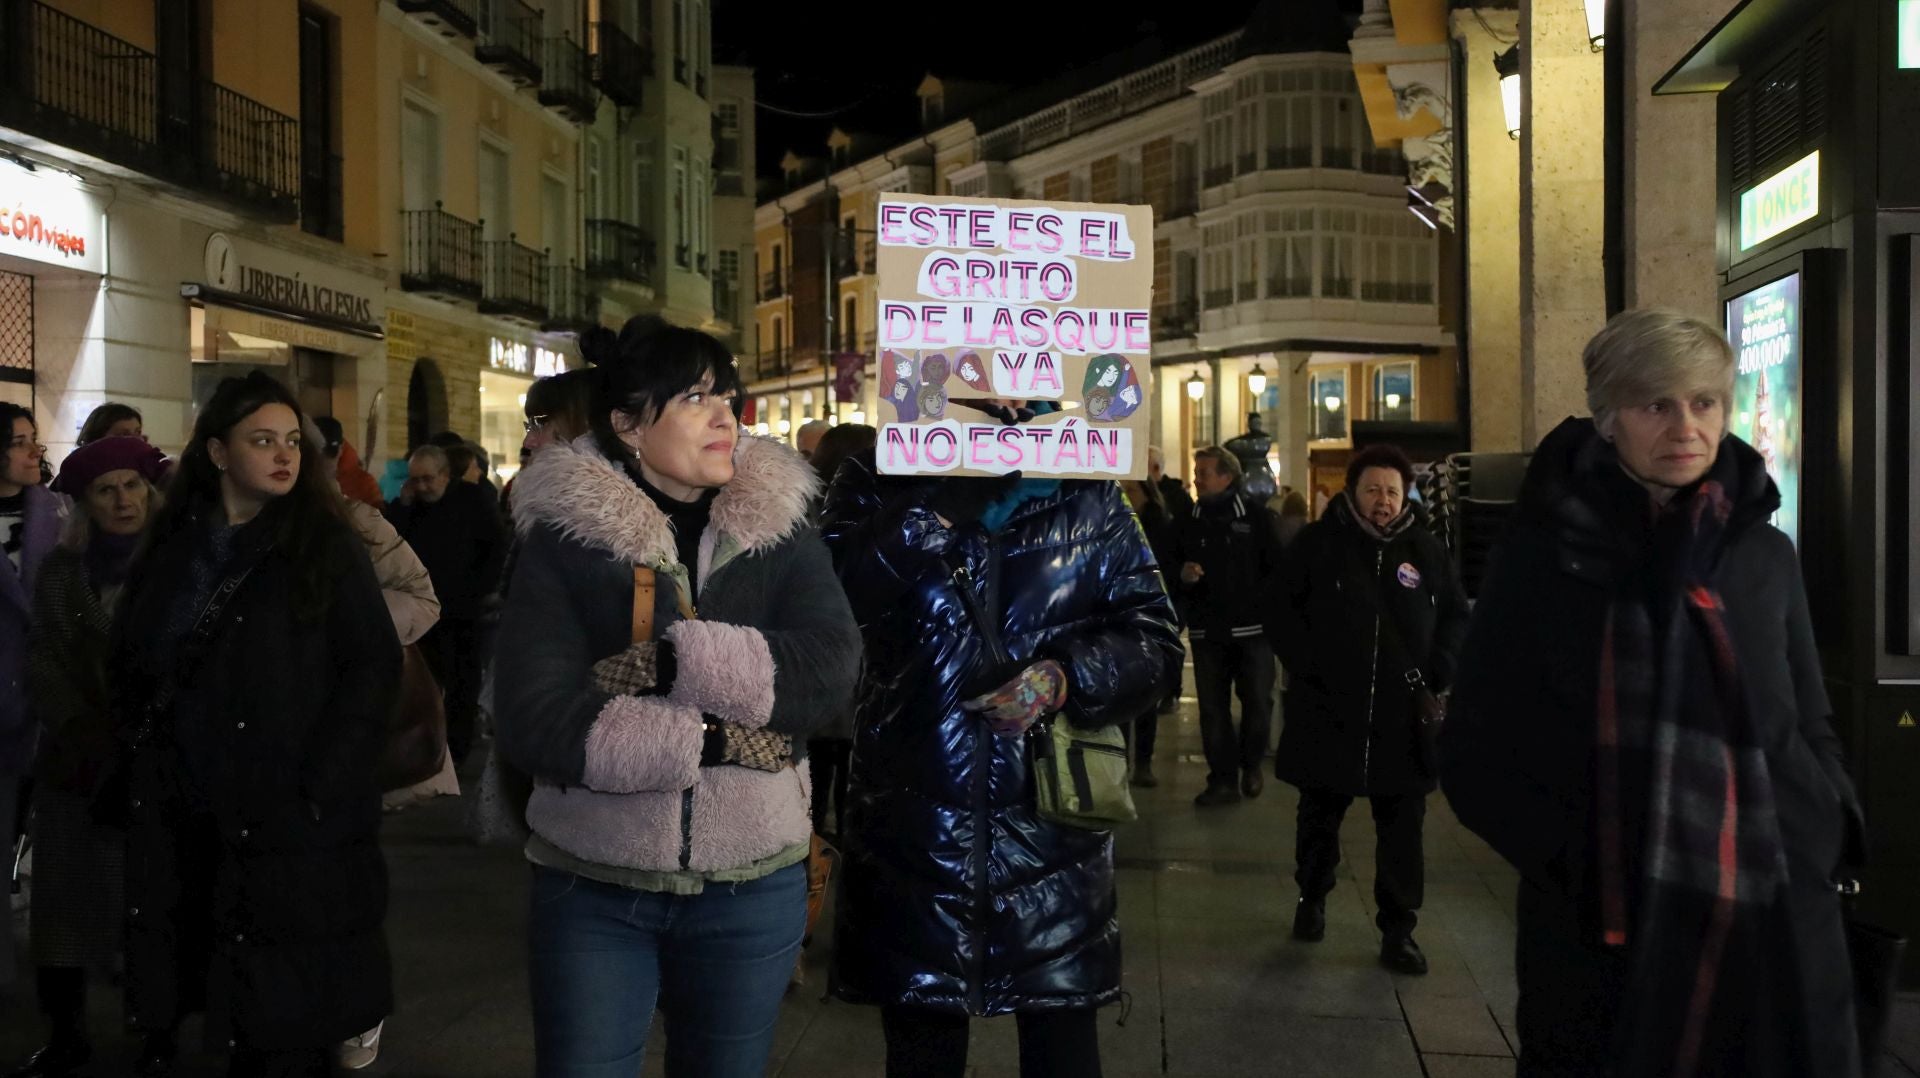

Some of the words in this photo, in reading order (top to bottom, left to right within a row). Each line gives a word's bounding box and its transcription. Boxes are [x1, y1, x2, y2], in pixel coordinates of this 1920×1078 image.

[1763, 167, 1811, 226] ONCE
[881, 205, 995, 247] ESTE
[1008, 212, 1064, 253] ES
[1080, 219, 1131, 259] EL
[239, 266, 311, 310] LIBRERÍA
[313, 284, 371, 323] IGLESIAS
[928, 257, 1073, 301] GRITO
[885, 304, 947, 343] DE
[998, 352, 1062, 391] YA
[886, 427, 957, 466] NO
[969, 418, 1118, 468] ESTÁN
